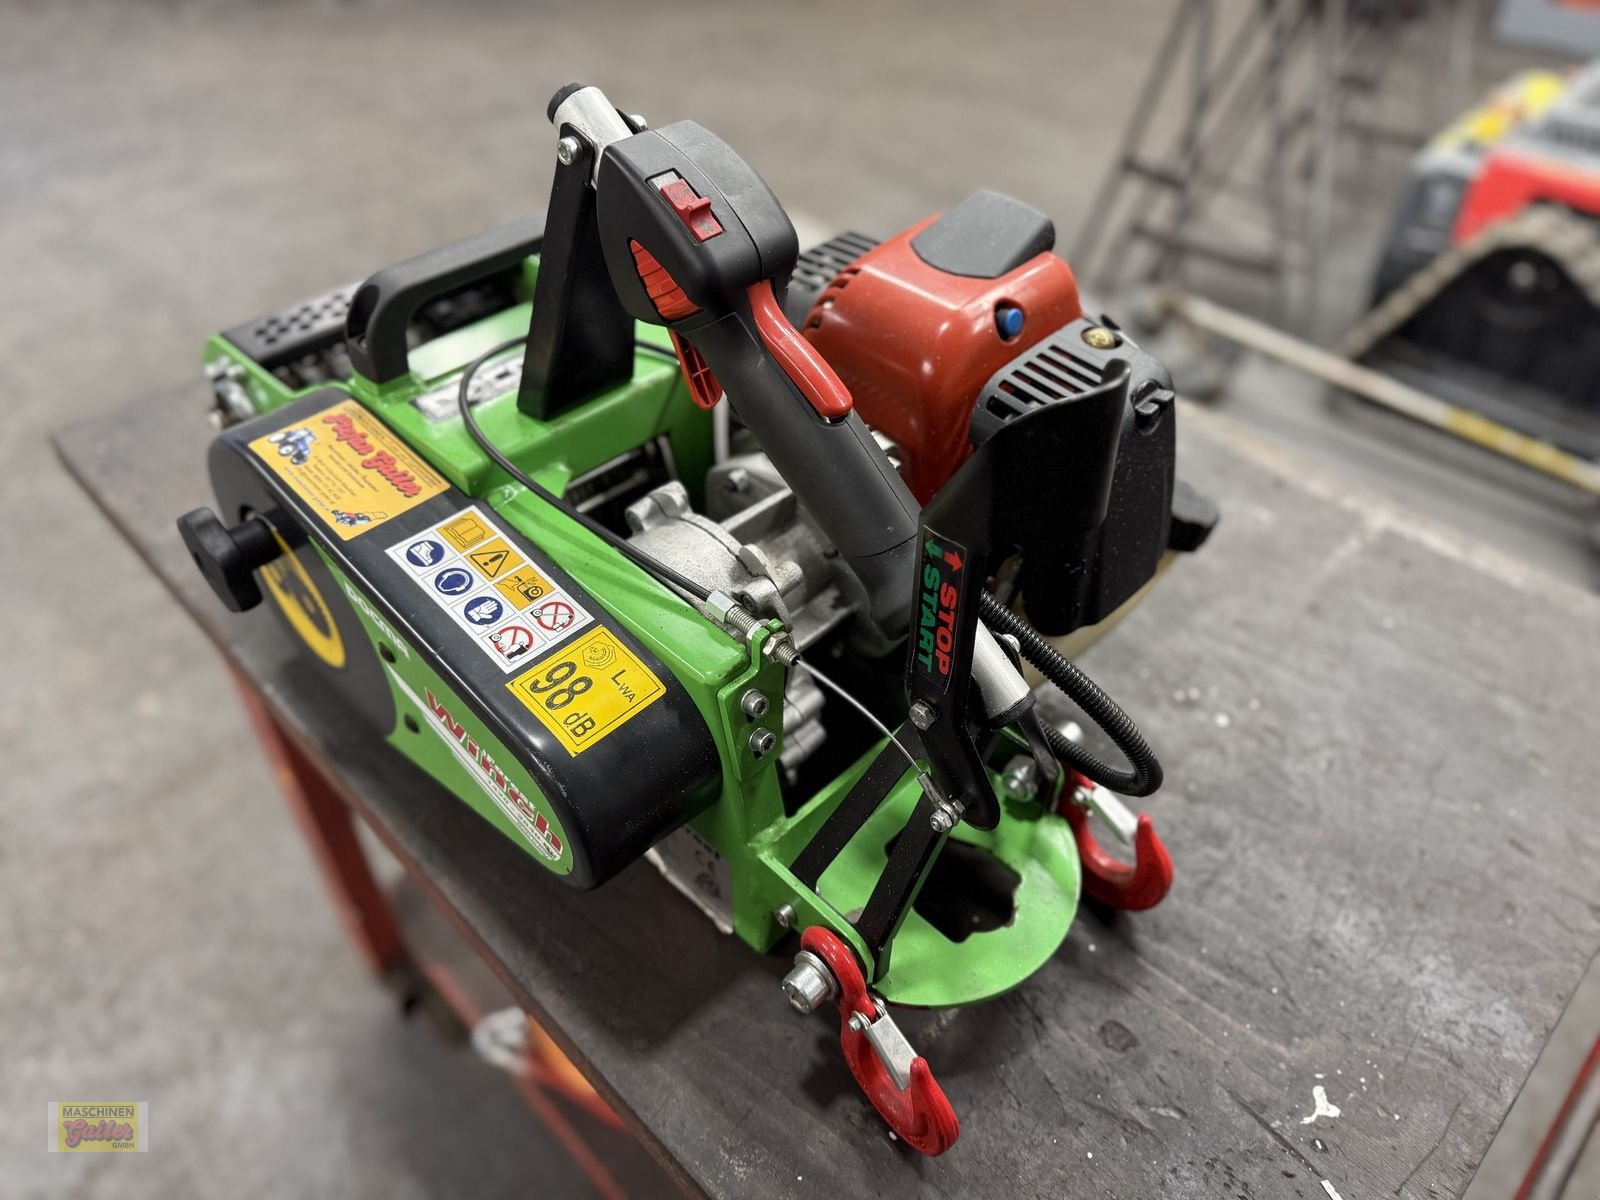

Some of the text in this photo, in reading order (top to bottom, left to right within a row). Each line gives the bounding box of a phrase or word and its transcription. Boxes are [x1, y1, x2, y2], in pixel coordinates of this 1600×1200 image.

[918, 563, 940, 673] START
[935, 582, 957, 676] STOP
[529, 661, 596, 738] 98 dB
[424, 686, 563, 853] Winch
